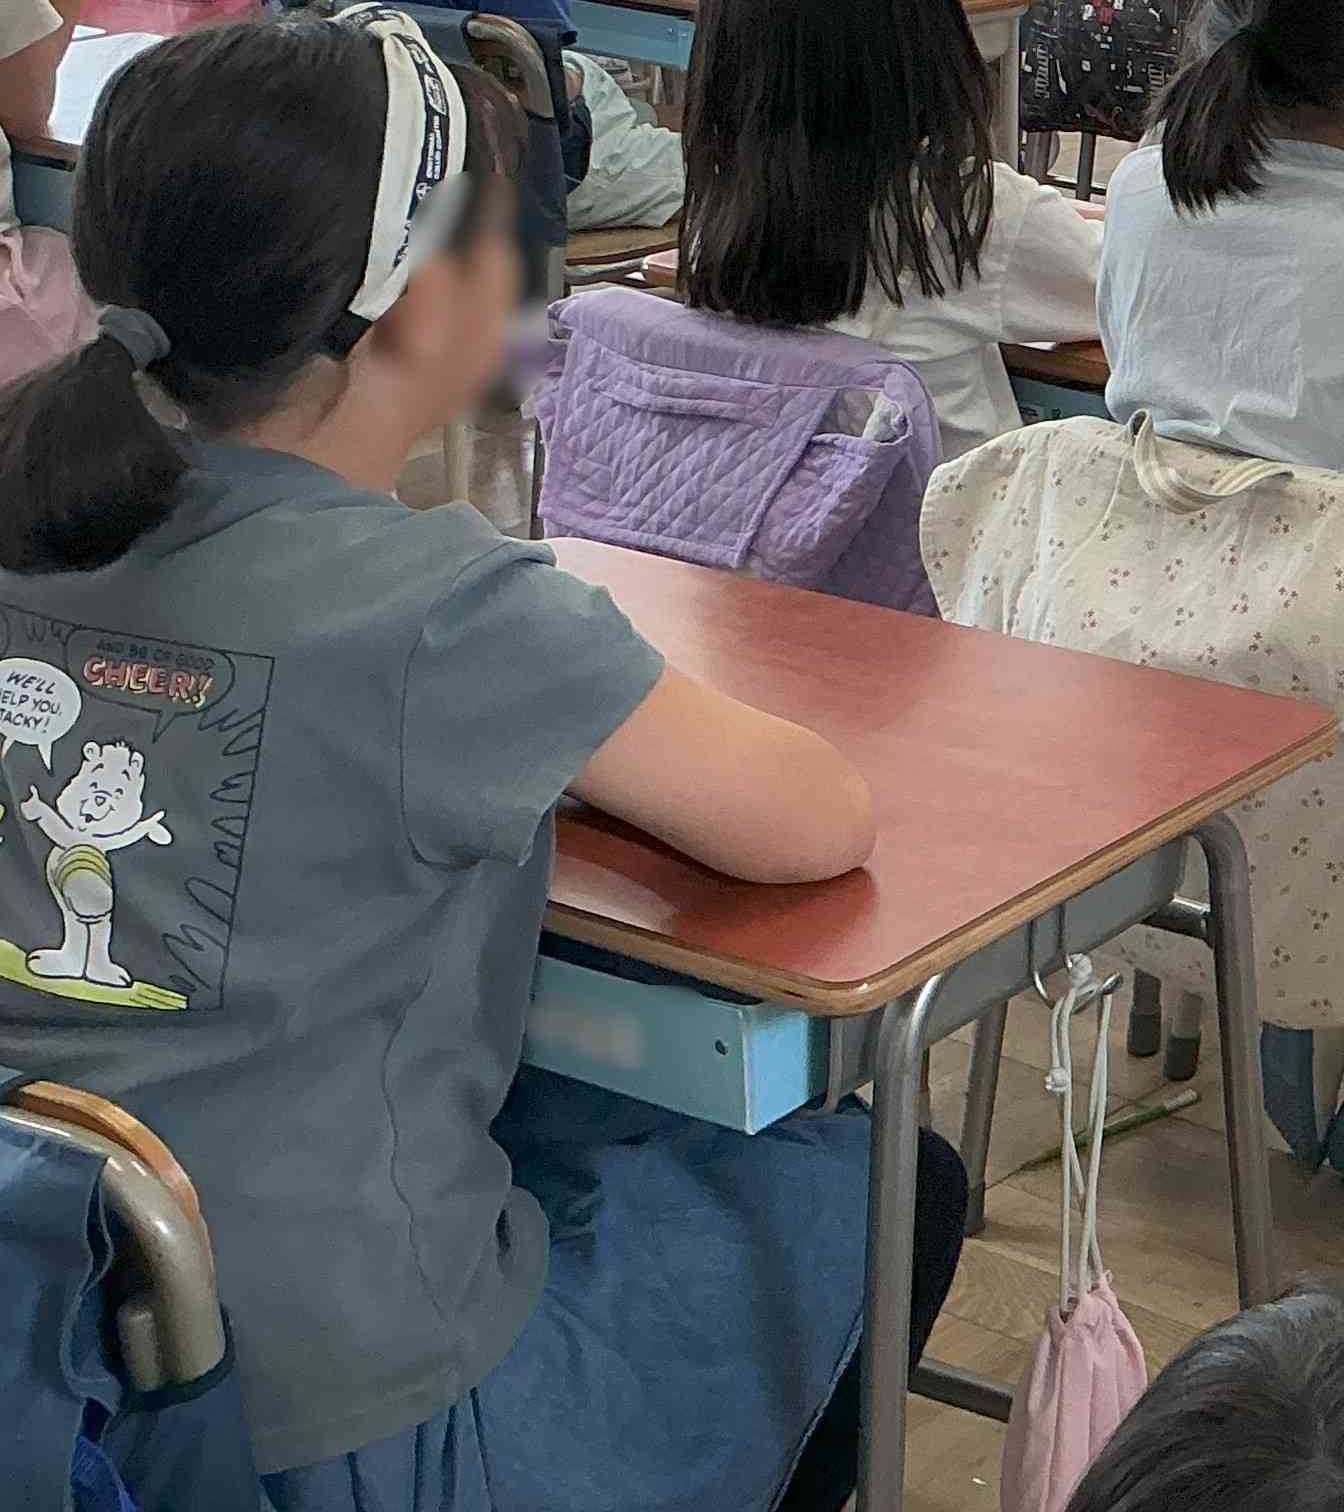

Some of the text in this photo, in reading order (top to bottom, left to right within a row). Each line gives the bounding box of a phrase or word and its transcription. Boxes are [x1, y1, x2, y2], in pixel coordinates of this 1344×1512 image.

[6, 671, 56, 695] WE'LL
[83, 655, 214, 708] CHEER!
[0, 689, 30, 707] ELP
